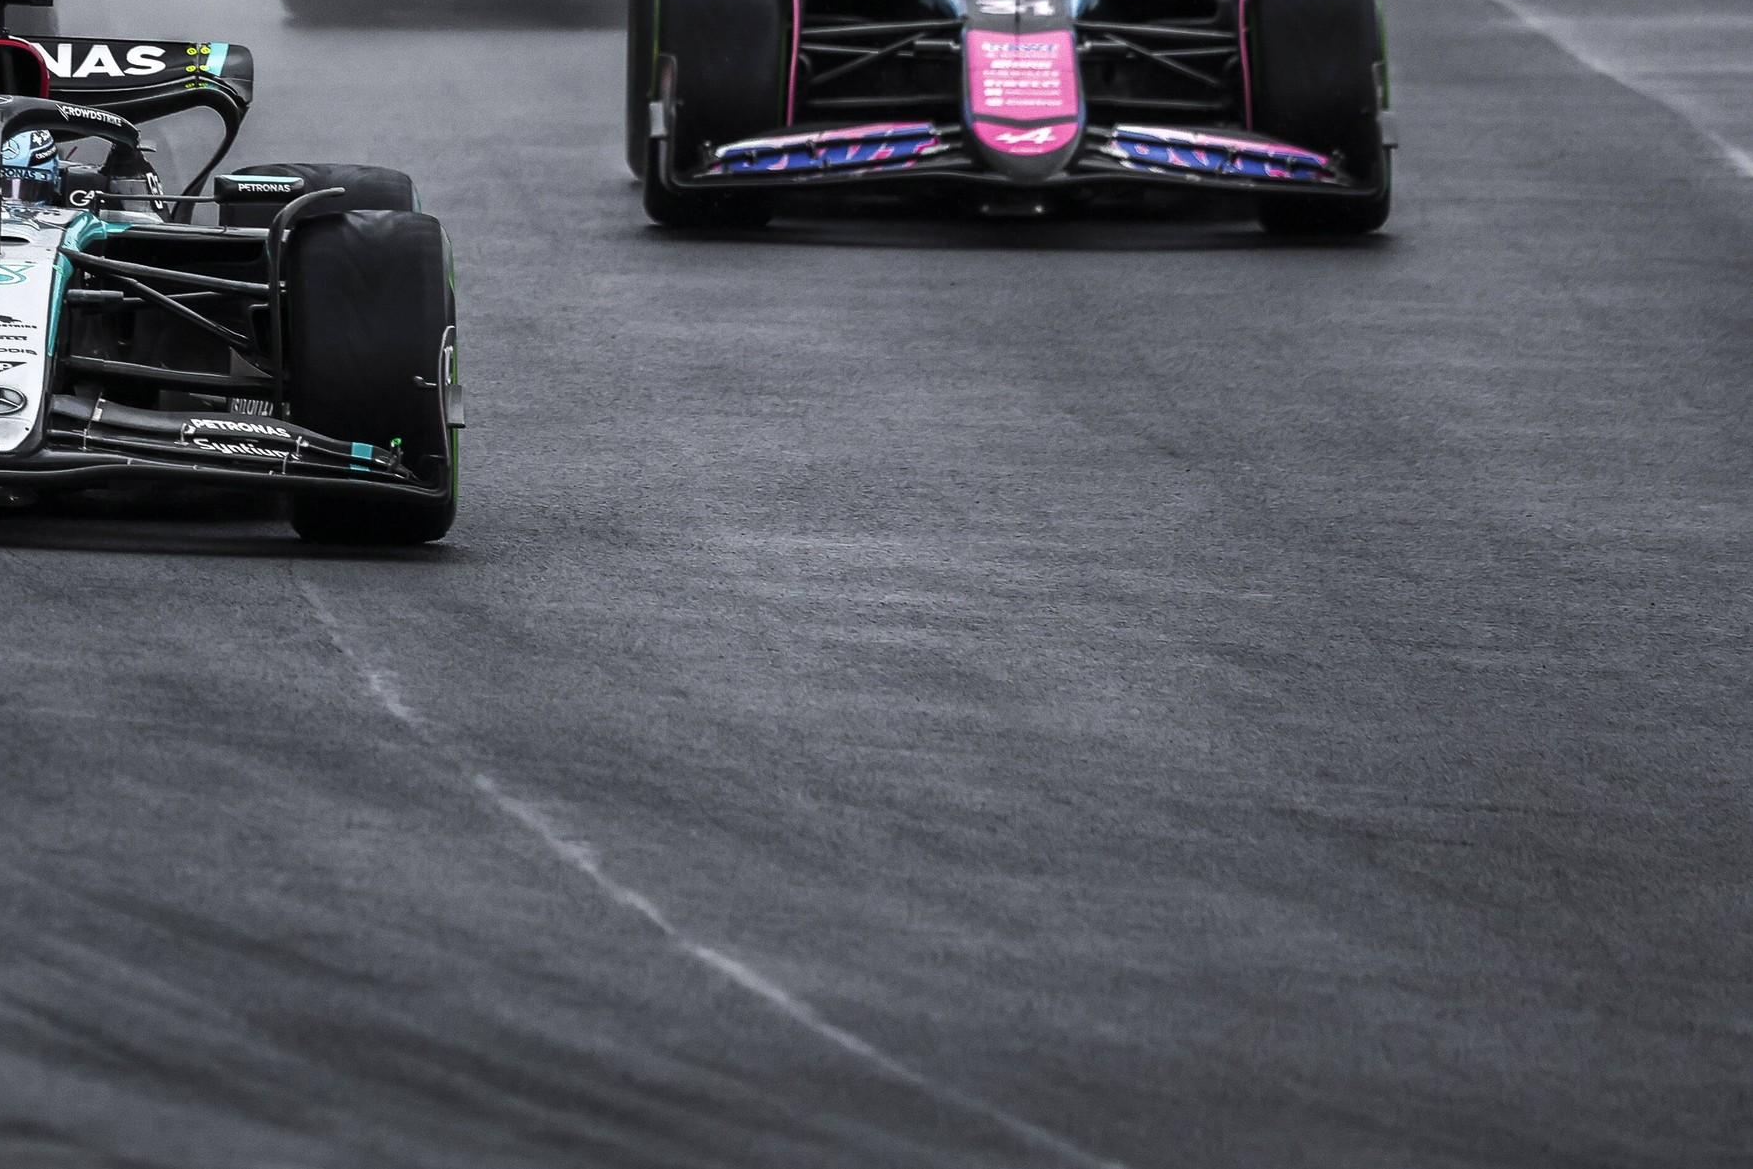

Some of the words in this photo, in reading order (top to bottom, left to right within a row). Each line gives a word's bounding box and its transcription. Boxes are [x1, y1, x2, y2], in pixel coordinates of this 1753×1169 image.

[61, 105, 122, 128] CROWDSTRIKE
[238, 183, 291, 194] PETRONAS
[190, 417, 292, 439] PETRONAS
